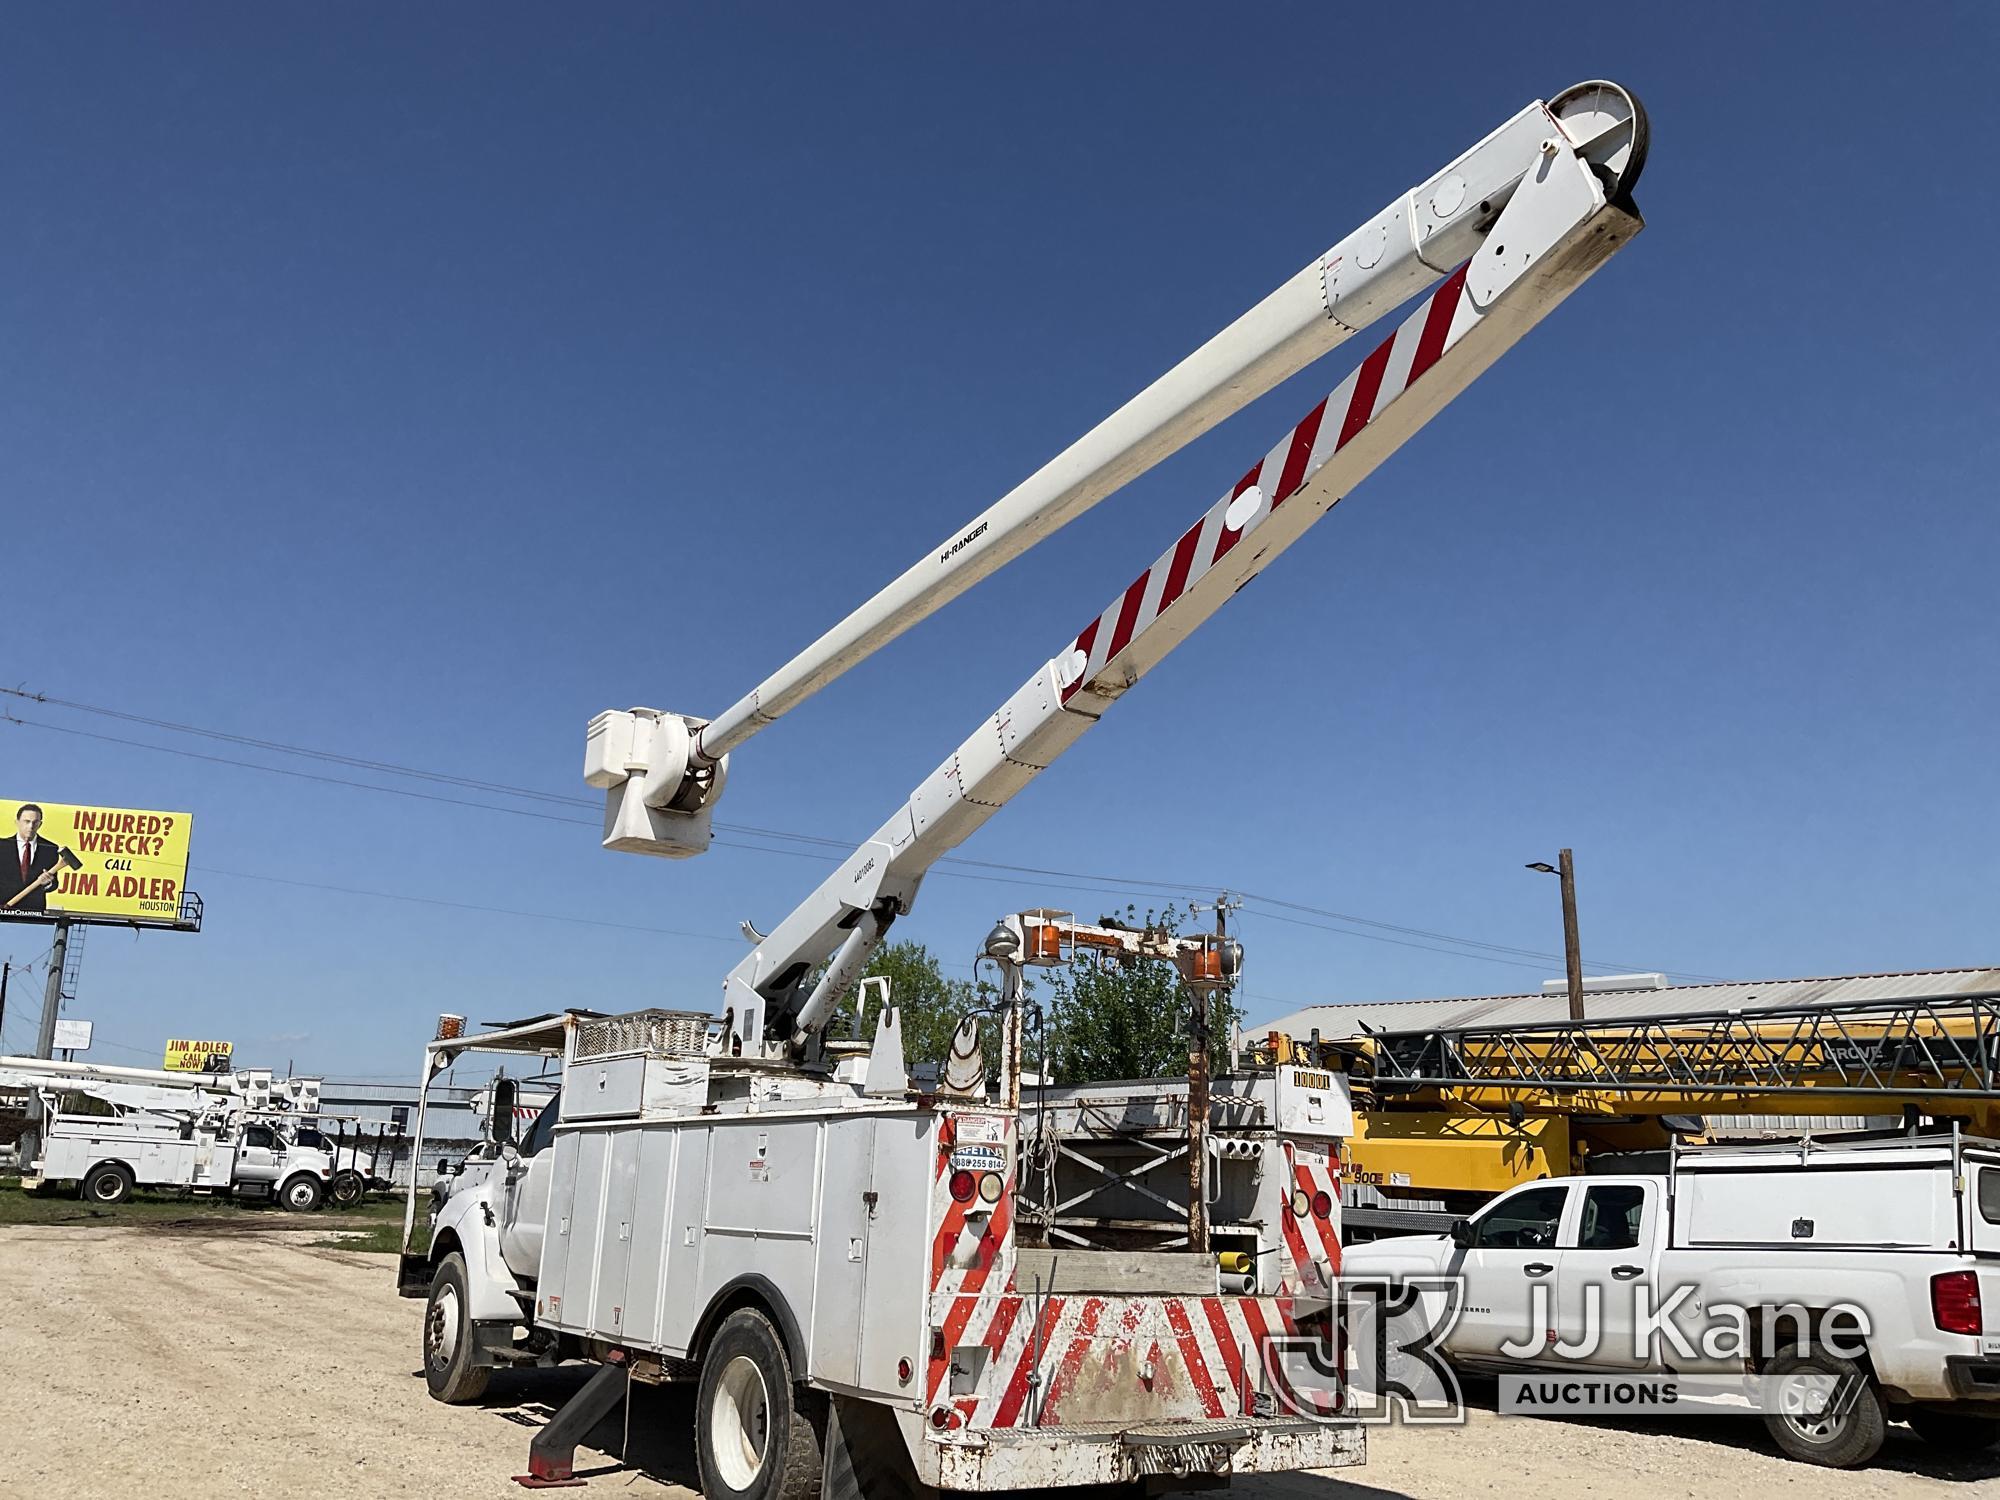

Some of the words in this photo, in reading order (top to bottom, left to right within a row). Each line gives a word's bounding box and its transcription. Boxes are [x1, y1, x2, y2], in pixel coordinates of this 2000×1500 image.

[941, 522, 987, 563] HI-RANGER
[73, 810, 174, 836] INJURED?
[79, 832, 164, 856] WRECK?
[104, 859, 132, 871] CALL
[58, 872, 98, 896] JIM
[105, 876, 176, 901] ADLER
[139, 901, 175, 912] HOUSTON
[168, 1040, 189, 1052] JIM
[193, 1042, 229, 1054] ADLER
[1824, 1046, 1884, 1060] GROVE
[183, 1053, 202, 1061] CALL
[180, 1061, 203, 1069] NOW!
[1294, 1072, 1330, 1090] 10001
[1354, 1172, 1384, 1185] 900E
